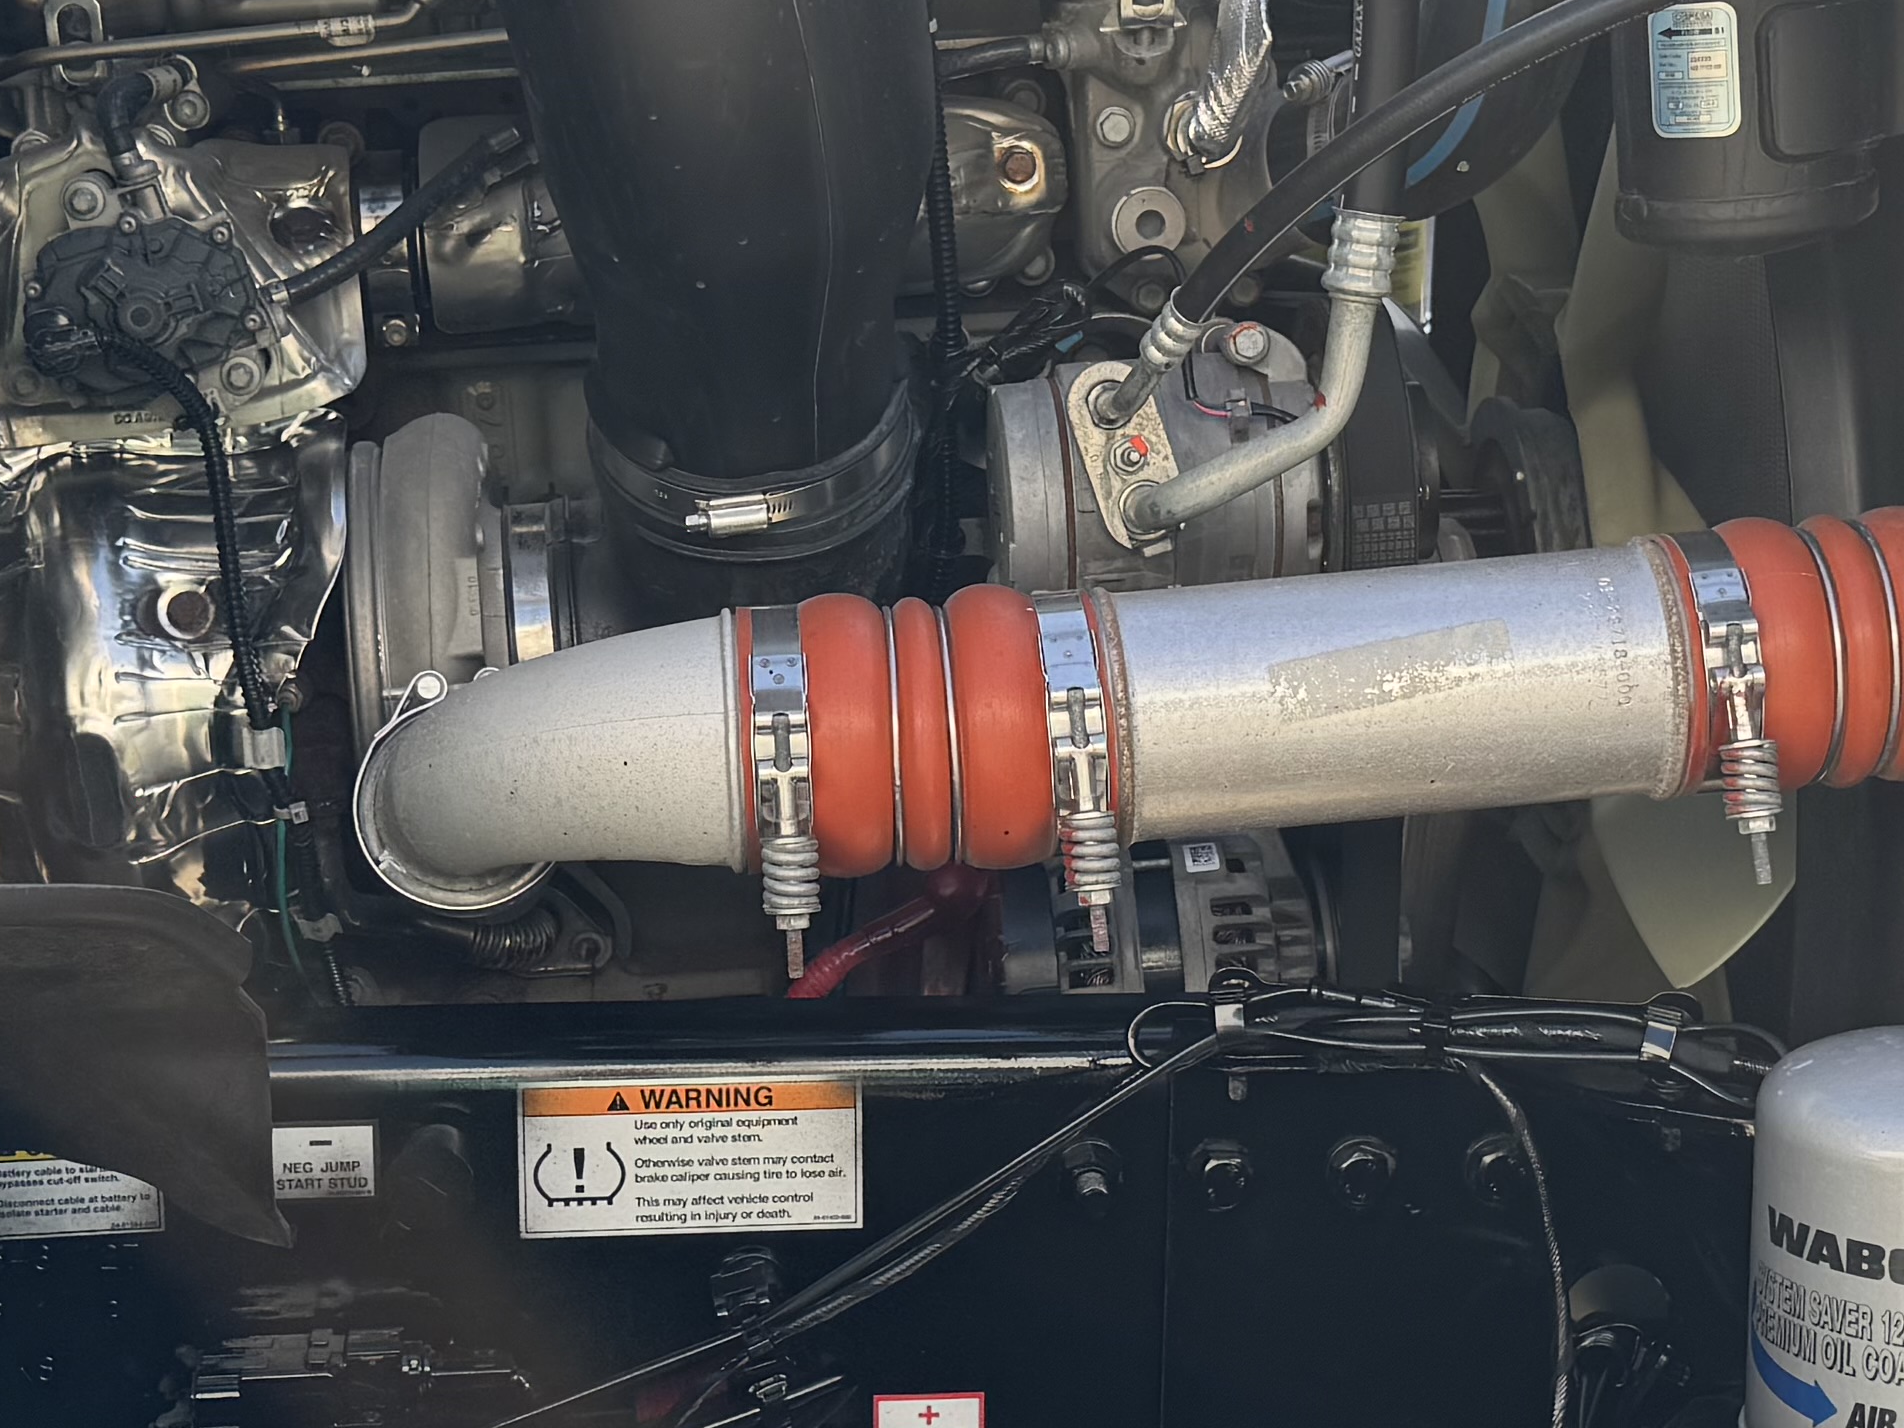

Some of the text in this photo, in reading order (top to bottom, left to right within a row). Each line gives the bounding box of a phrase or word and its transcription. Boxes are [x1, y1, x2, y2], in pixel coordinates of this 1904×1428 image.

[640, 1086, 774, 1110] WARNING
[634, 1116, 798, 1131] Use only original equipment
[634, 1132, 763, 1145] wheel and valve stem.
[282, 1161, 360, 1174] NEG JUMP
[634, 1153, 834, 1169] Otherwise valve stem may contact
[35, 1166, 63, 1178] cable
[65, 1166, 77, 1176] to
[634, 1167, 847, 1185] brake caliper causing tire to lose air.
[276, 1177, 368, 1190] START STUD
[58, 1195, 86, 1206] cable
[87, 1195, 98, 1205] at
[101, 1193, 137, 1206] battery
[635, 1191, 814, 1208] This may affect vehicle control
[72, 1205, 92, 1214] and
[635, 1208, 792, 1224] resulting in injury or death.
[1808, 1289, 1873, 1342] SAVER
[1754, 1307, 1817, 1366] PREMIUM
[1820, 1338, 1856, 1378] OIL
